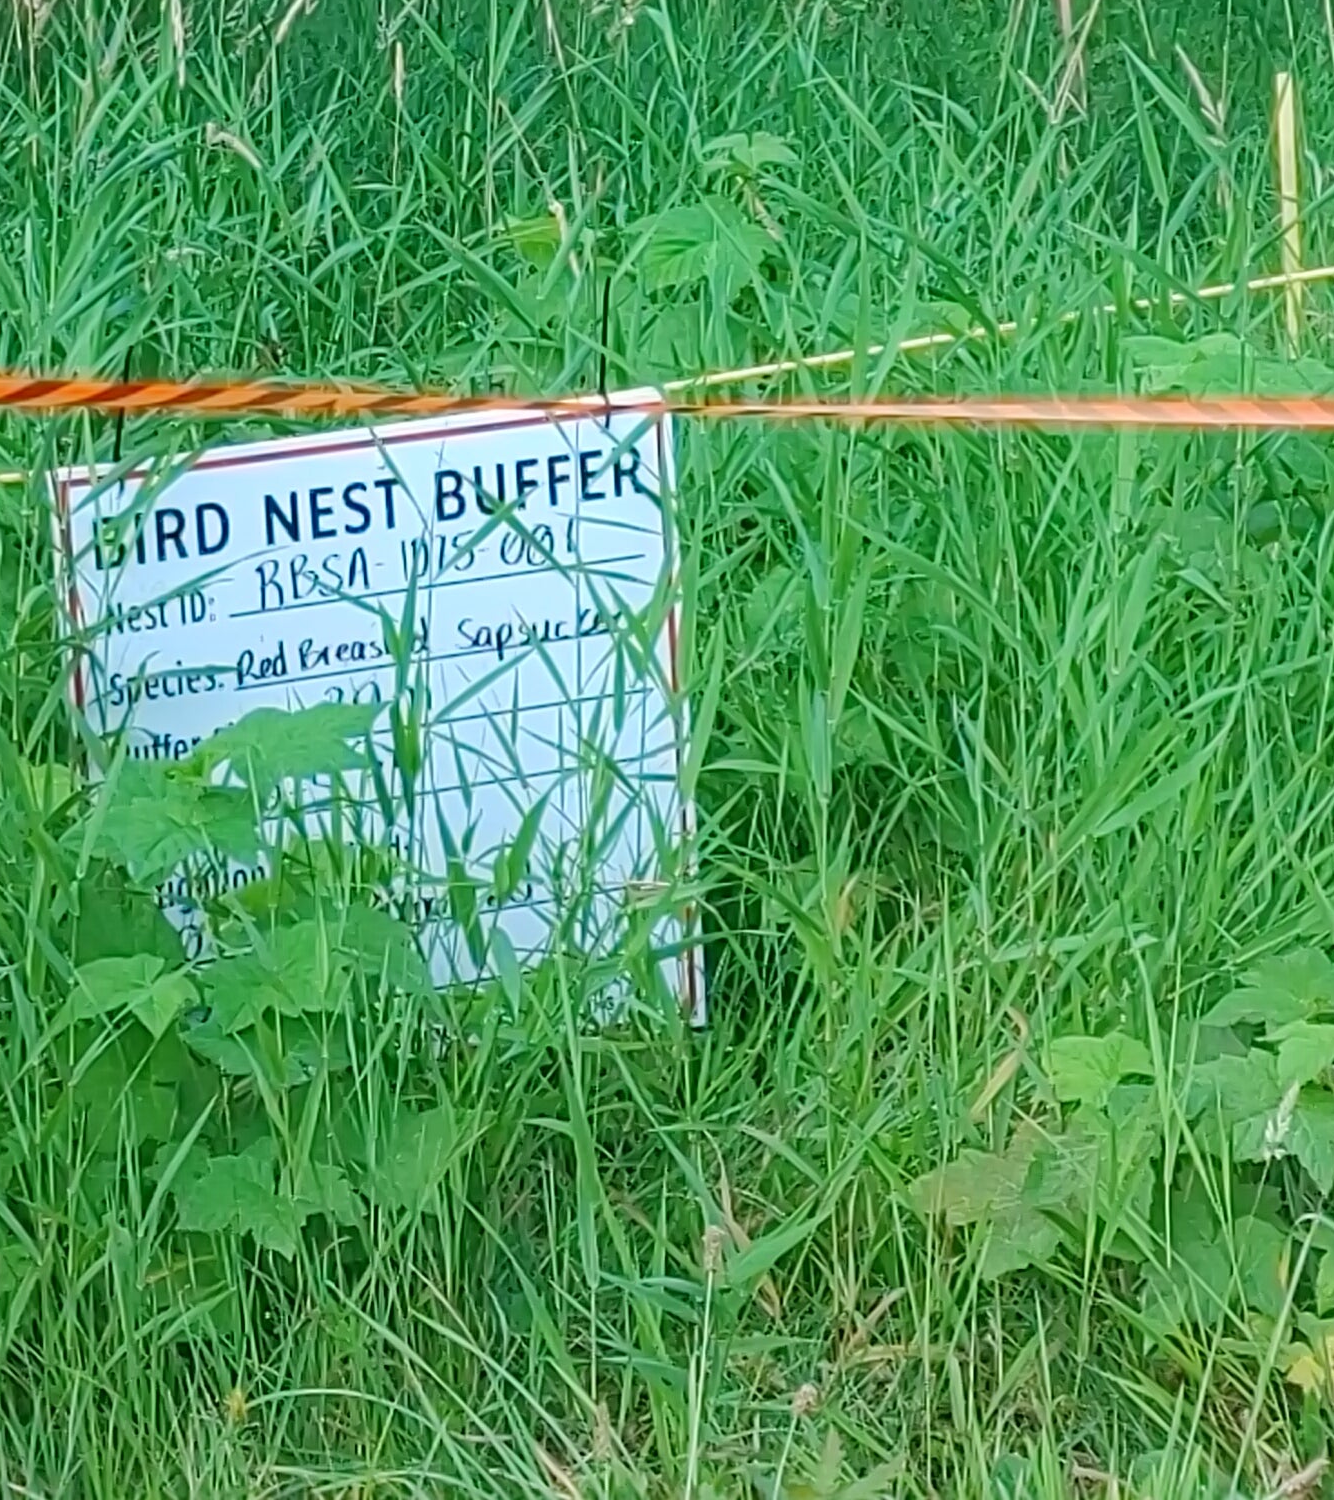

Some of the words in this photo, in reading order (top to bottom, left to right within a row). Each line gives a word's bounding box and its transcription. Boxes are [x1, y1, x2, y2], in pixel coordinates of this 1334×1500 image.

[93, 502, 230, 570] BIRD
[264, 477, 401, 546] NEST
[435, 446, 646, 522] BUFFER
[235, 640, 288, 686] Red
[298, 616, 430, 673] Breasd
